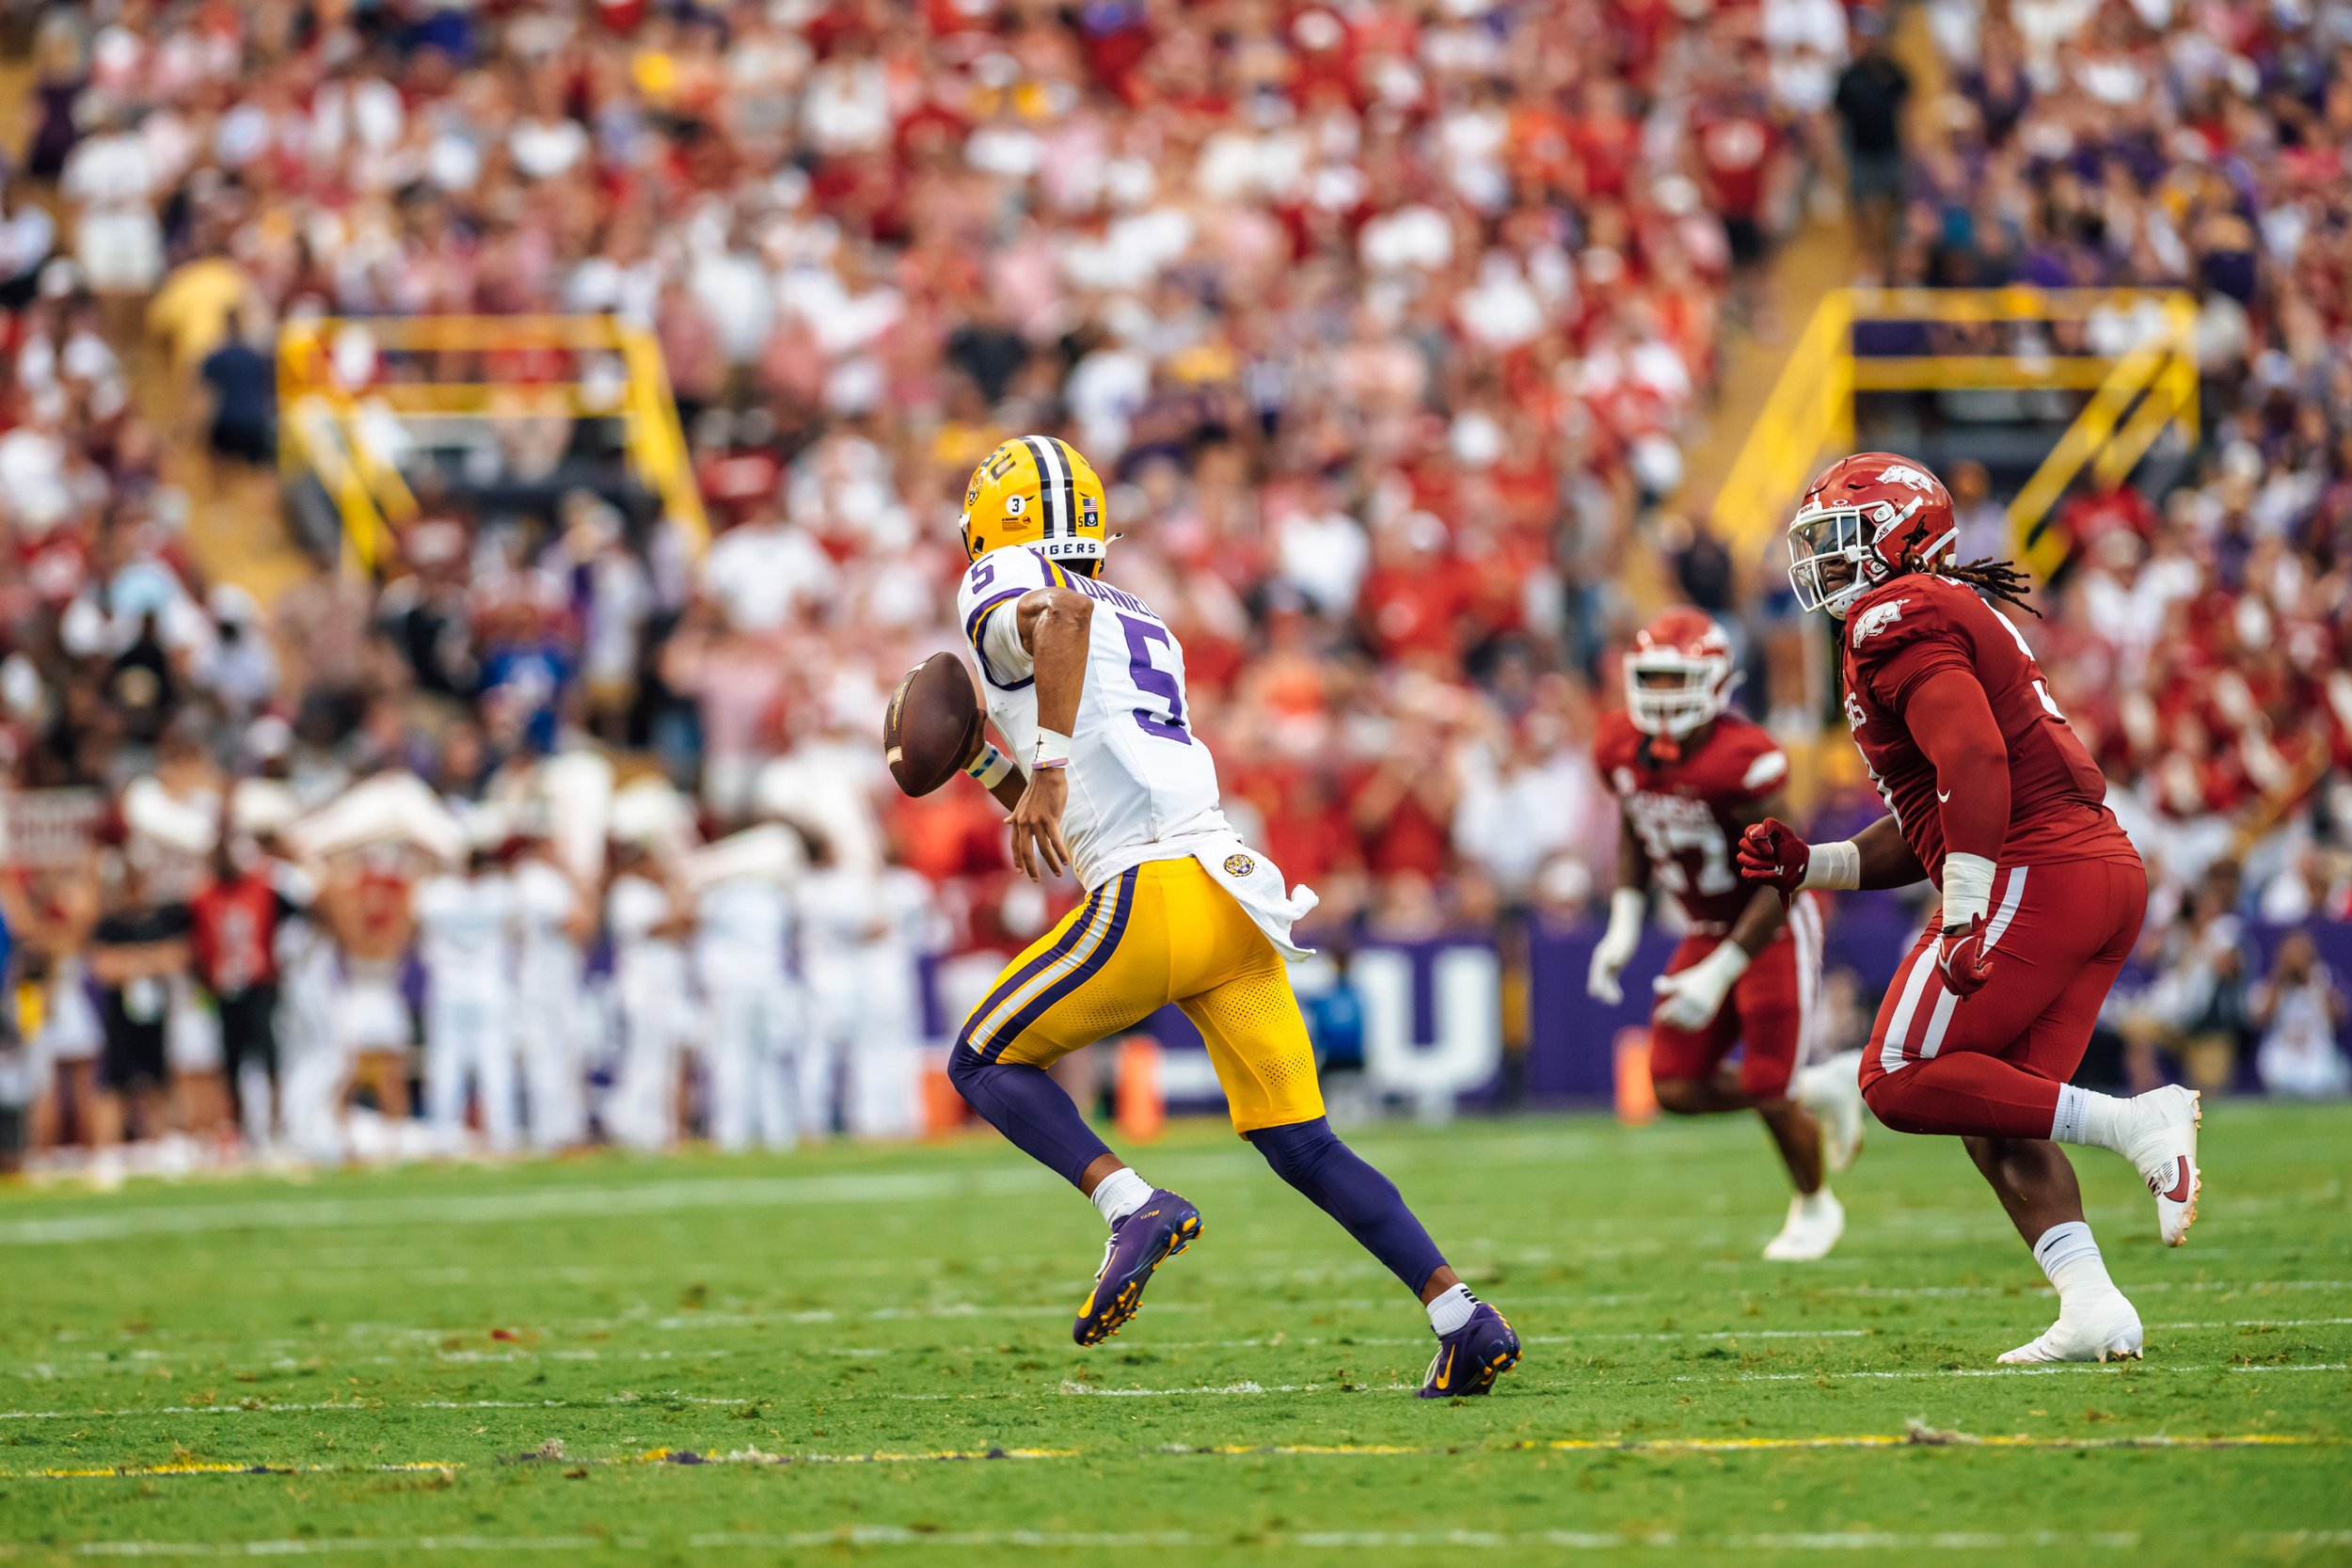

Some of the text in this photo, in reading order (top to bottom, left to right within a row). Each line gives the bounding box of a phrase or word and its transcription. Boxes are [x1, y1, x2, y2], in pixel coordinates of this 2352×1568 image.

[1012, 498, 1020, 513] 3
[1078, 516, 1084, 528] 5
[1031, 543, 1096, 556] IGERS
[971, 554, 995, 595] 5
[1115, 611, 1192, 746] 5
